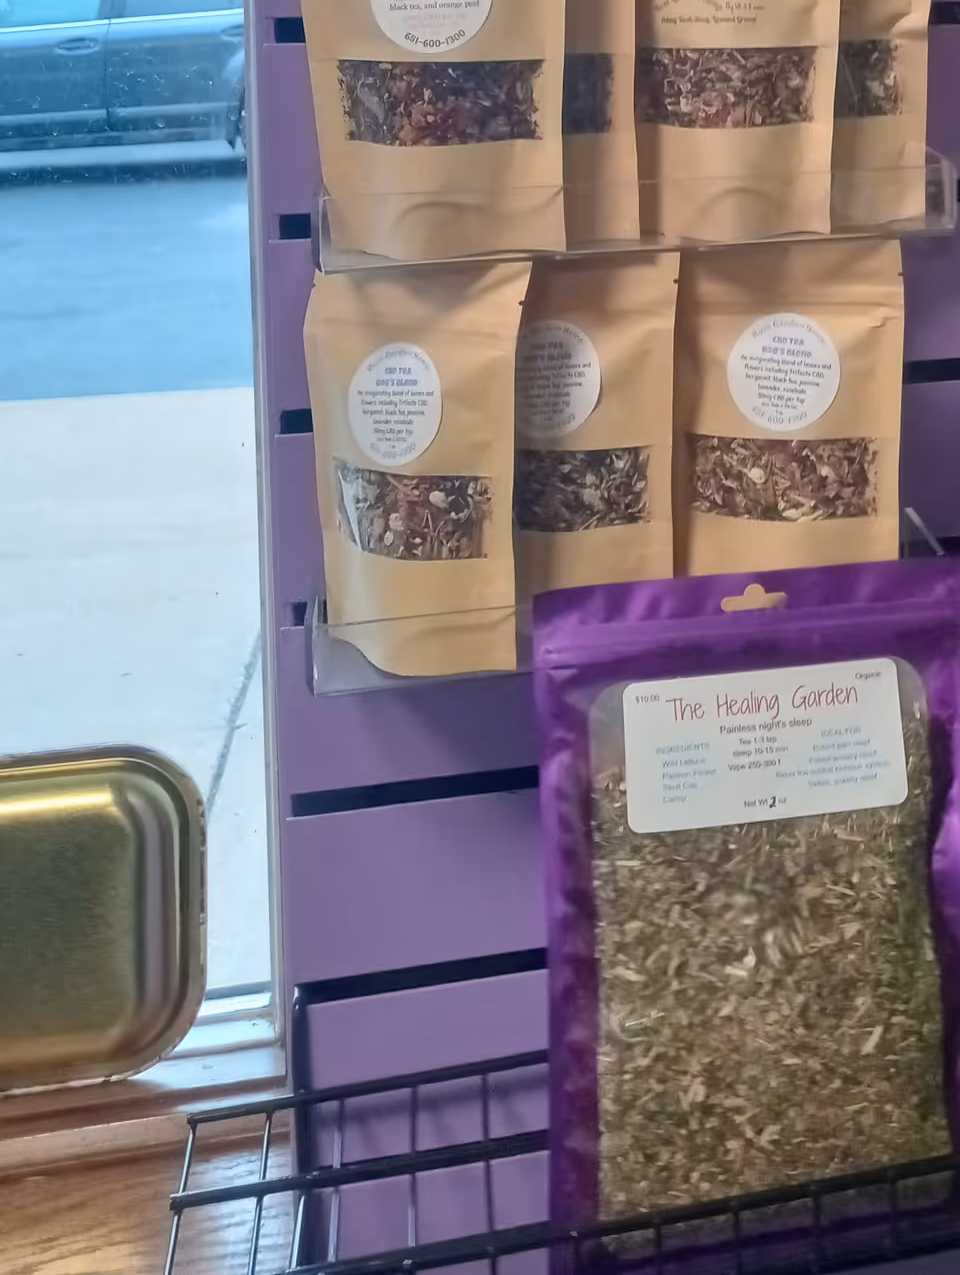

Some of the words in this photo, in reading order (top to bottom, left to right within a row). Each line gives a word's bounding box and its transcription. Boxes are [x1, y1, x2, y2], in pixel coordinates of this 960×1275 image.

[389, 3, 408, 11] black
[424, 1, 437, 9] and
[438, 1, 464, 10] orange
[404, 28, 466, 48] 651-600-1300
[855, 671, 882, 681] Organic
[635, 693, 660, 704] $10.00
[665, 697, 706, 722] The
[716, 690, 780, 720] Healing
[791, 682, 858, 711] Garden
[719, 723, 757, 735] Painless
[758, 719, 787, 732] night's
[788, 717, 813, 729] sleep
[754, 747, 774, 755] 10-15
